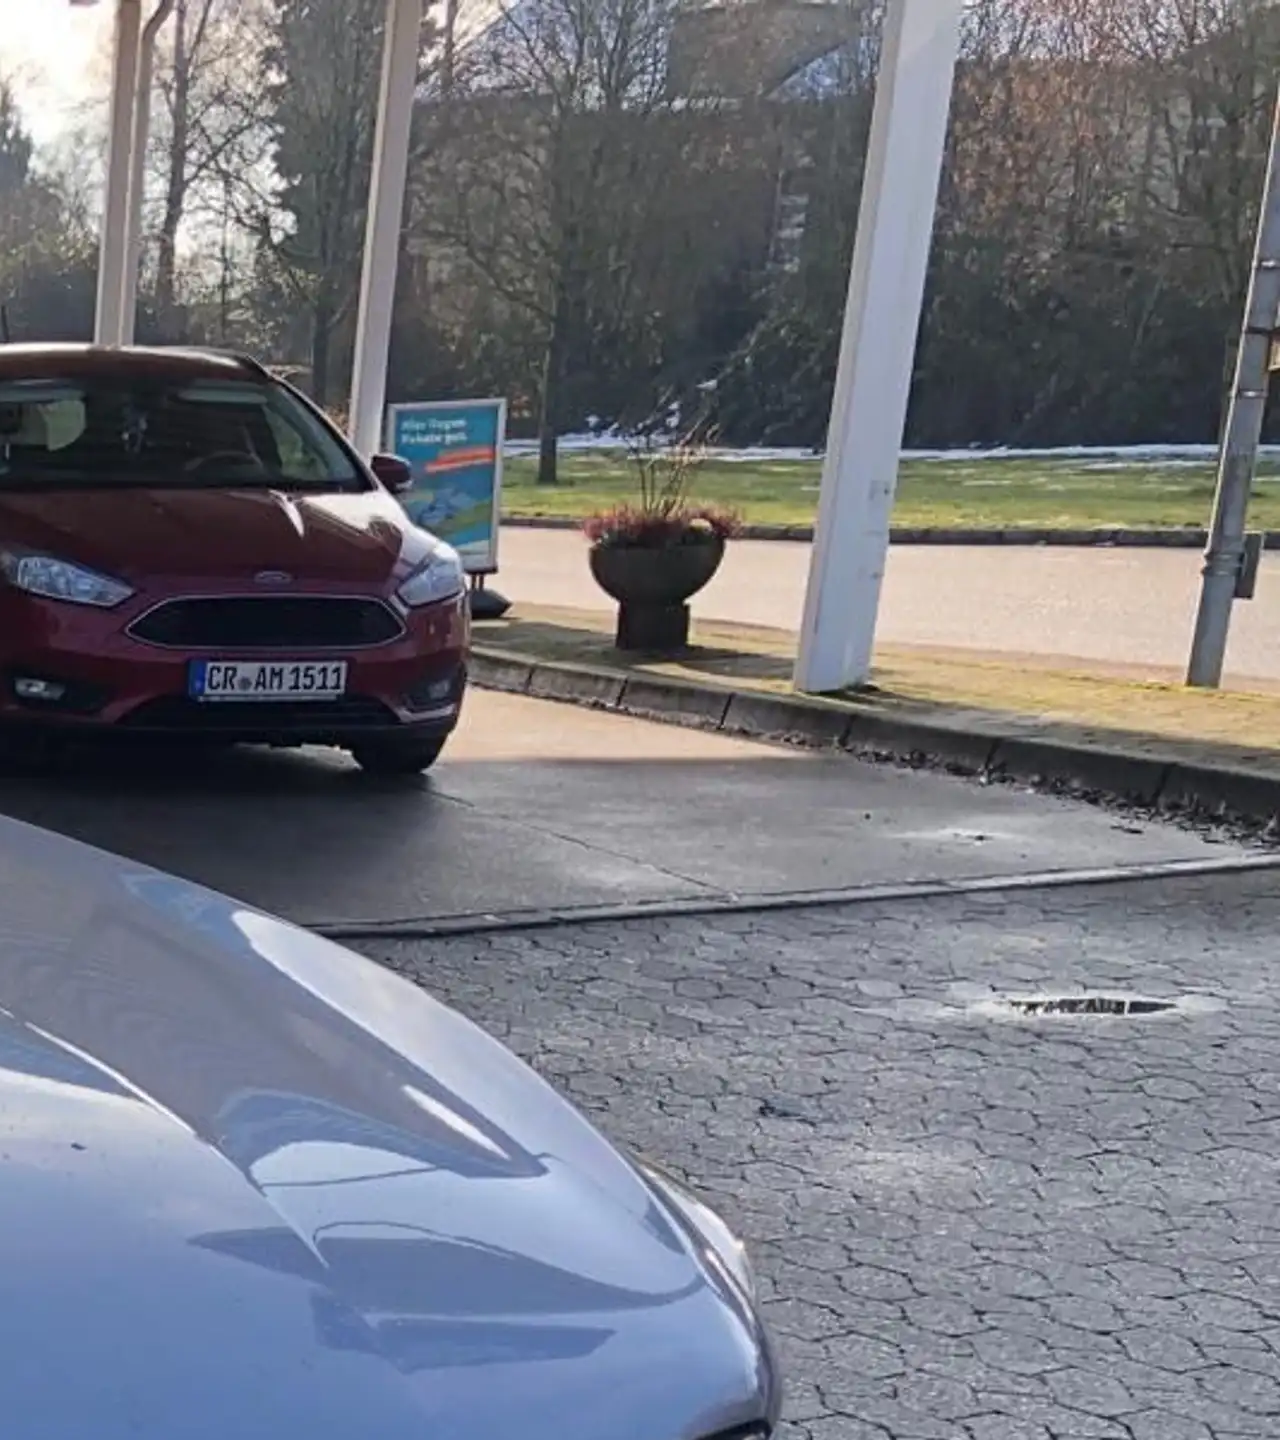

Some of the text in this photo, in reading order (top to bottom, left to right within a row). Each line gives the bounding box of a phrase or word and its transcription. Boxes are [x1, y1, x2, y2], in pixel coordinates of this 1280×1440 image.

[207, 665, 341, 690] CR AM 1511
